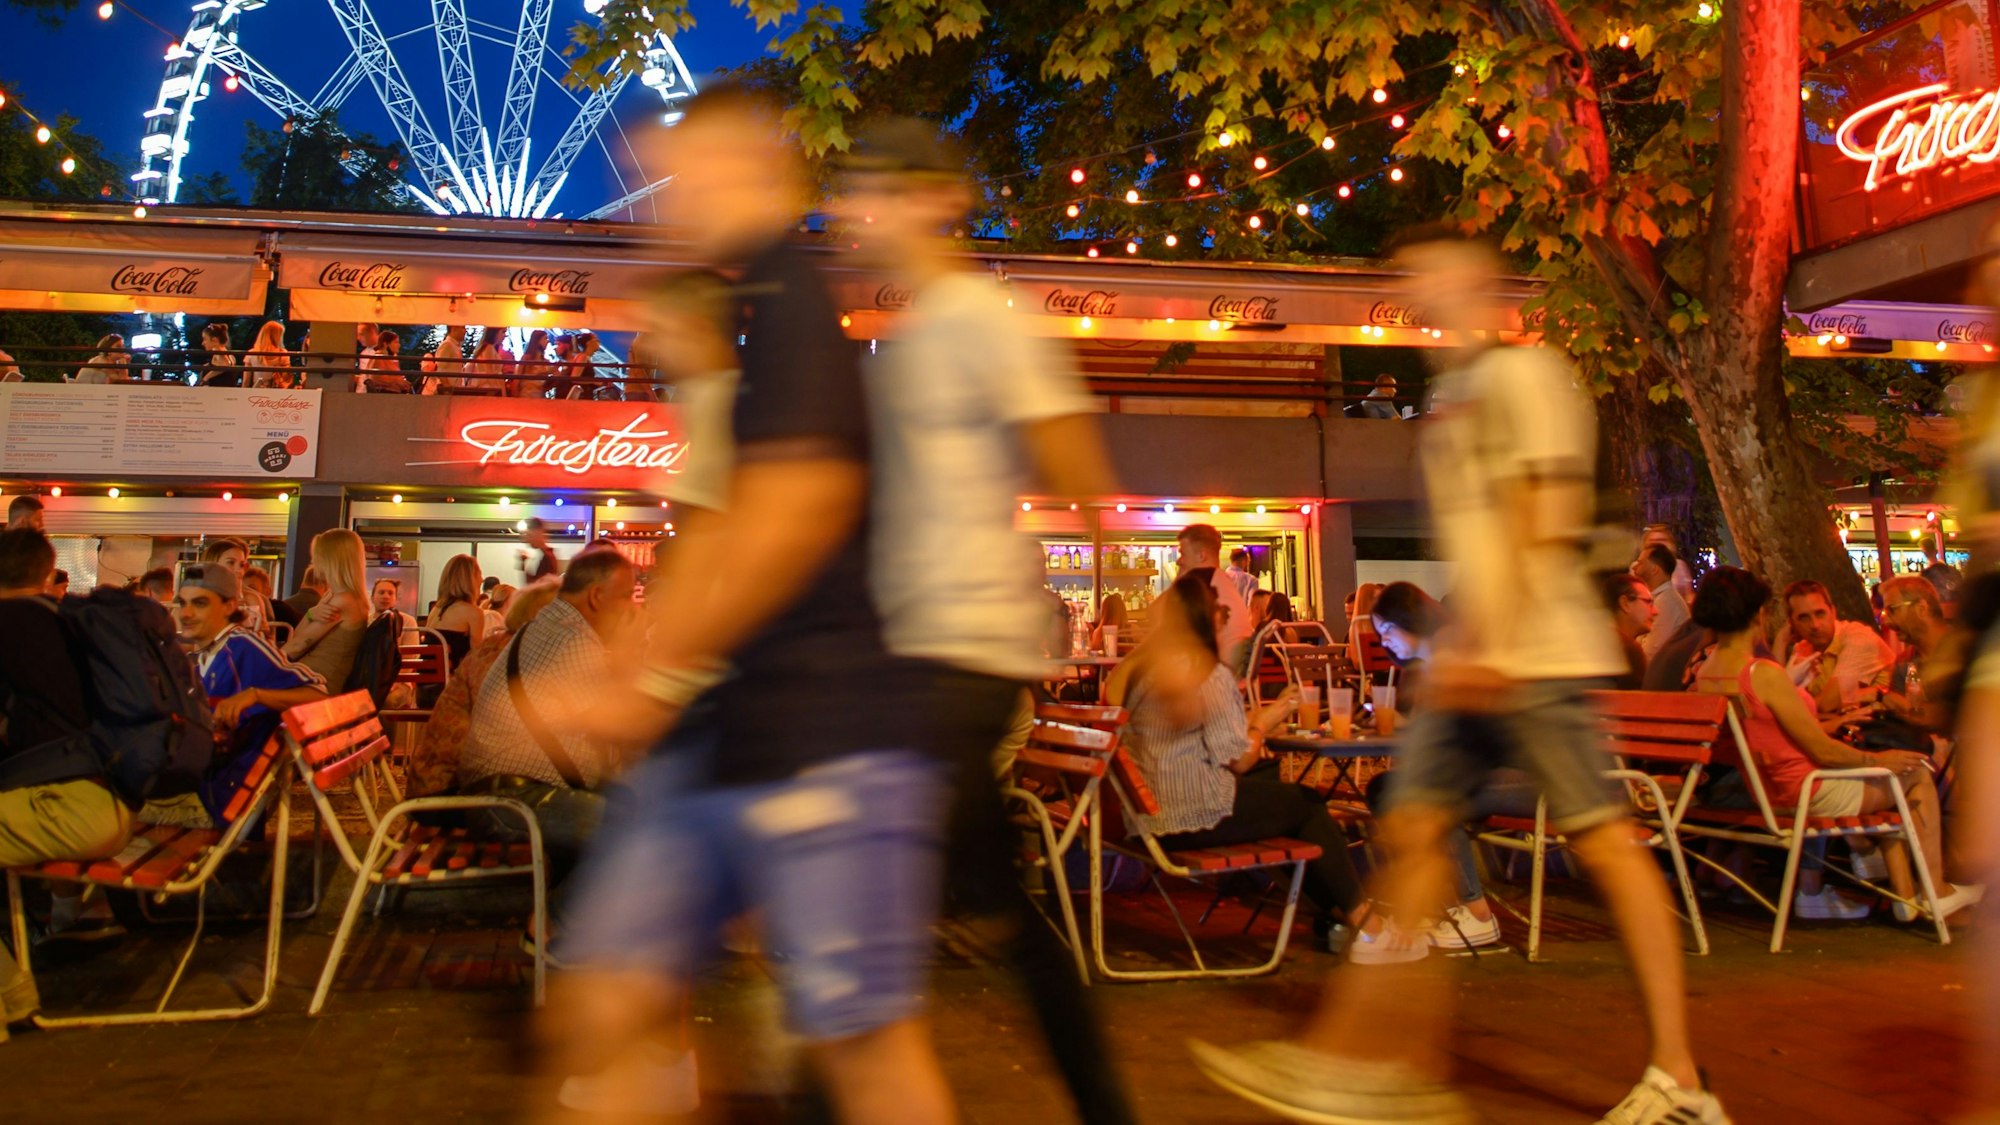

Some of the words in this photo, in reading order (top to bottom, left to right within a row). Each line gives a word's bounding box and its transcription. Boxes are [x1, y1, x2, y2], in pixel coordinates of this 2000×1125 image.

[110, 264, 205, 295] Coca-Cola
[318, 261, 408, 290] Coca-Cola
[508, 268, 593, 294] Coca-Cola
[1044, 288, 1120, 315] Coca-Cola
[1208, 294, 1281, 321] Coca-Cola
[1369, 301, 1428, 326] Coca-Col
[1808, 313, 1867, 335] Coca-Cola
[264, 454, 287, 463] MERAKI
